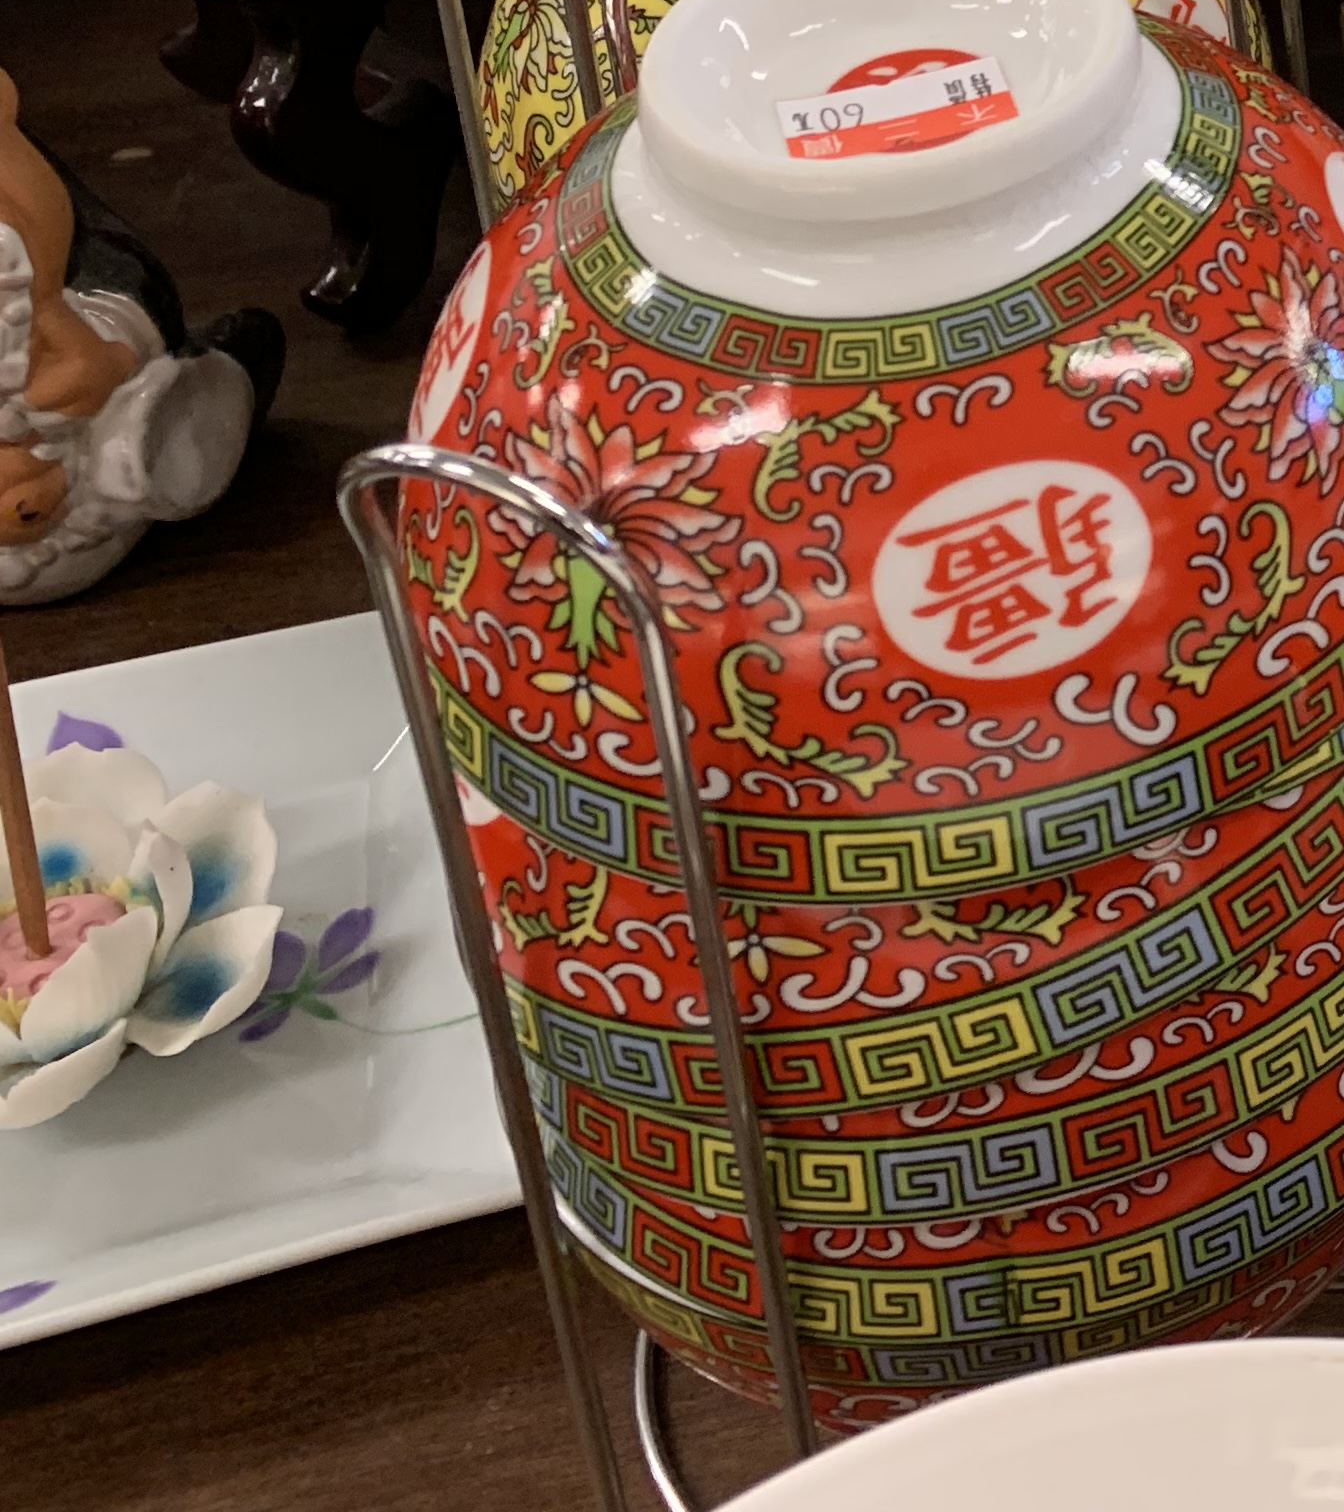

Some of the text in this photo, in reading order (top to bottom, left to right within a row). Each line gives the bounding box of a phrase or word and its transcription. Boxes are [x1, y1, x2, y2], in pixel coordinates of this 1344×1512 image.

[791, 102, 865, 137] 60元
[799, 103, 999, 159] 不二價
[895, 483, 1120, 667] 疆
